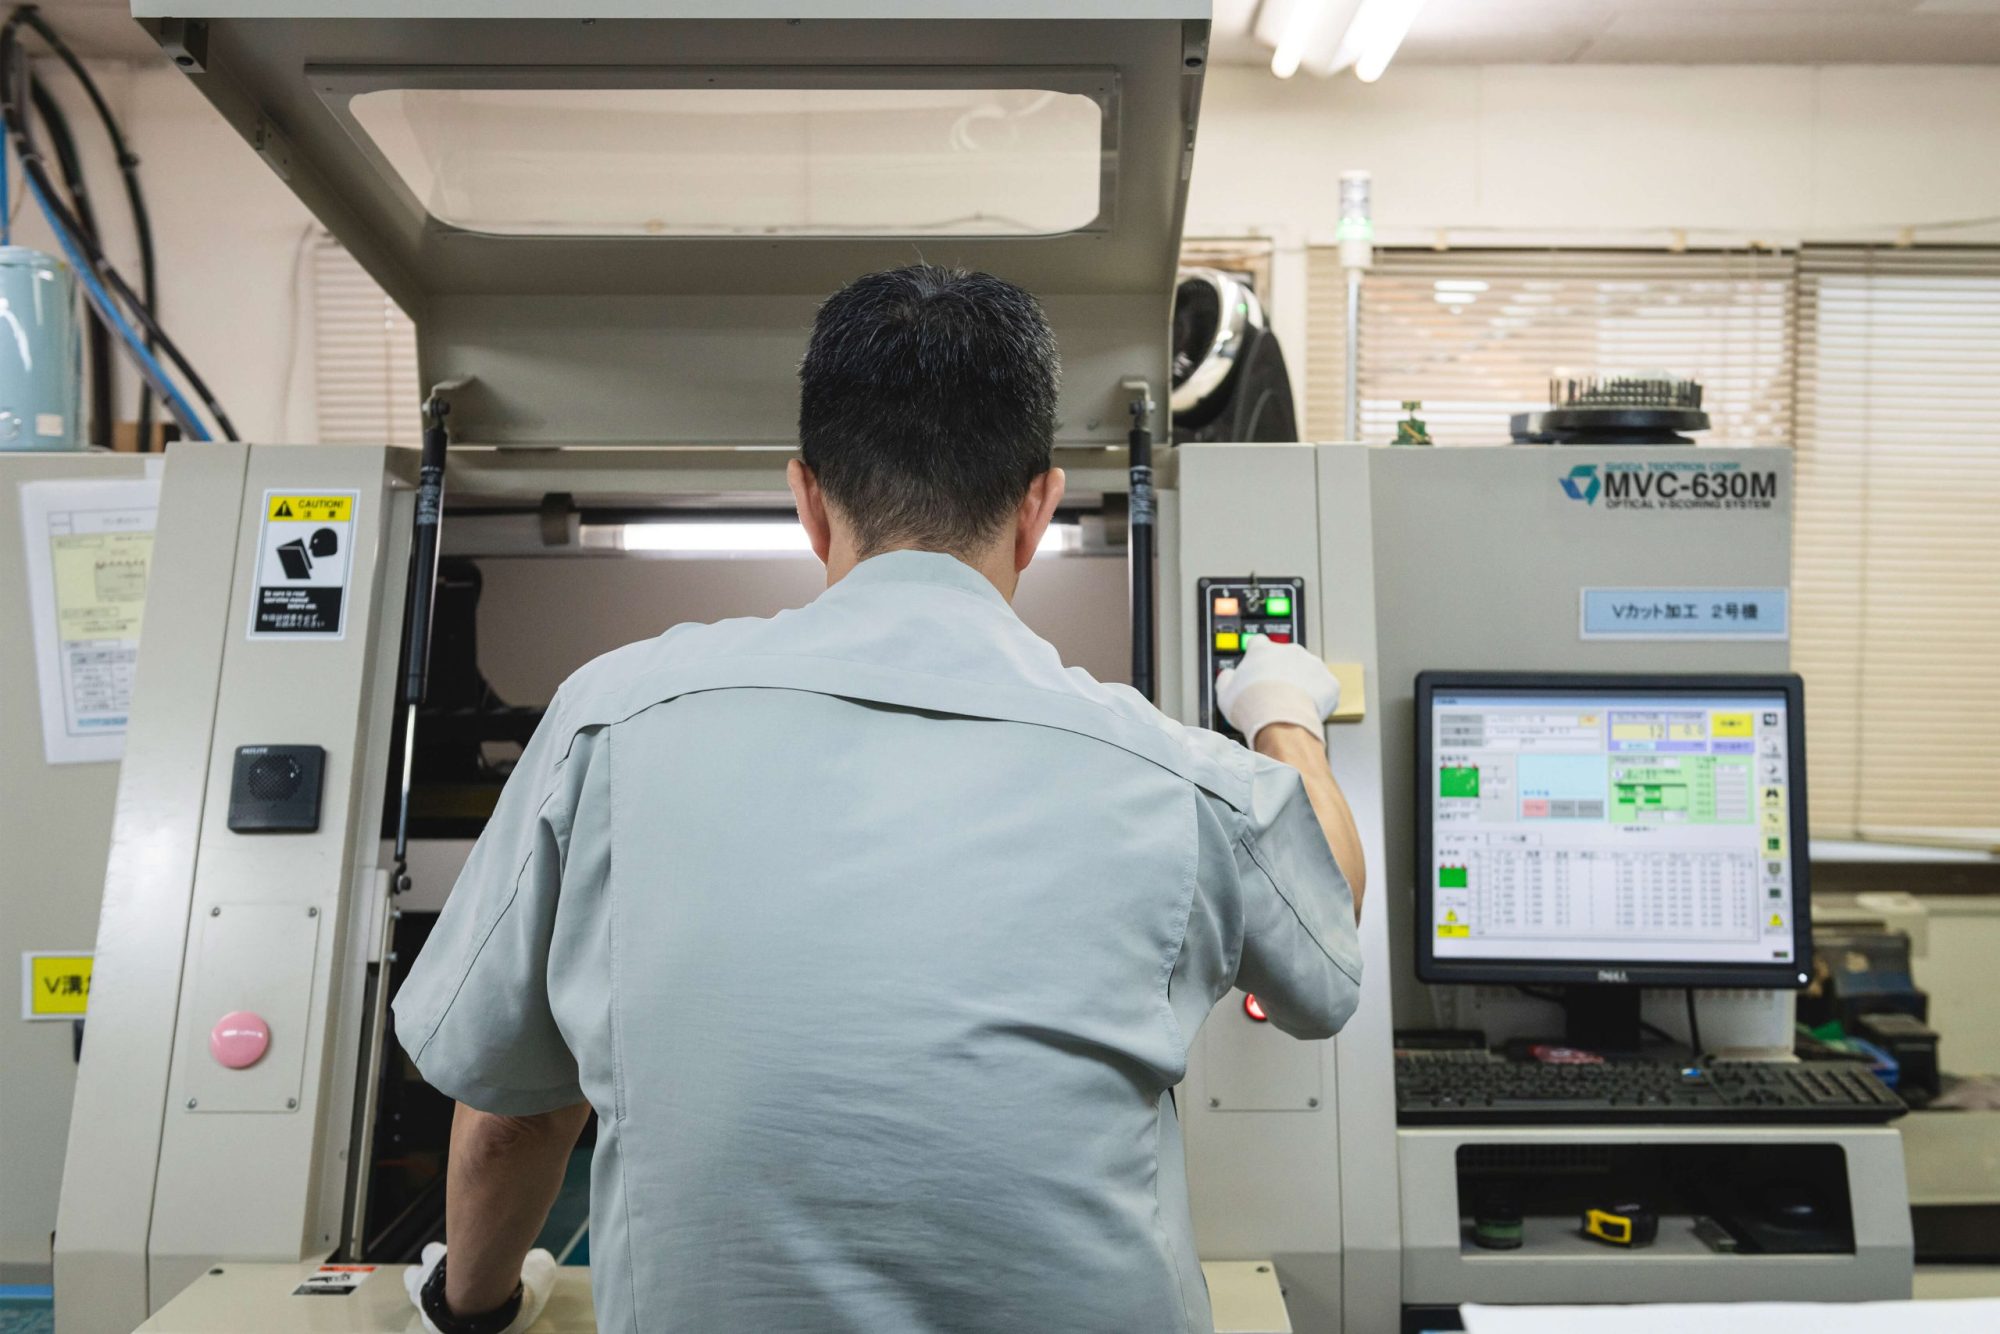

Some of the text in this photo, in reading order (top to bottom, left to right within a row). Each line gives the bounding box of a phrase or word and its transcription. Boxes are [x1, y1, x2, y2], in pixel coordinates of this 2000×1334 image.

[1604, 471, 1776, 498] MVC-630M
[298, 499, 345, 509] CAUTION!
[1605, 499, 1772, 509] OPTICAL V-SCORING SYSTEM
[1611, 602, 1759, 621] Vカット加工 2号機
[43, 974, 92, 996] V溝
